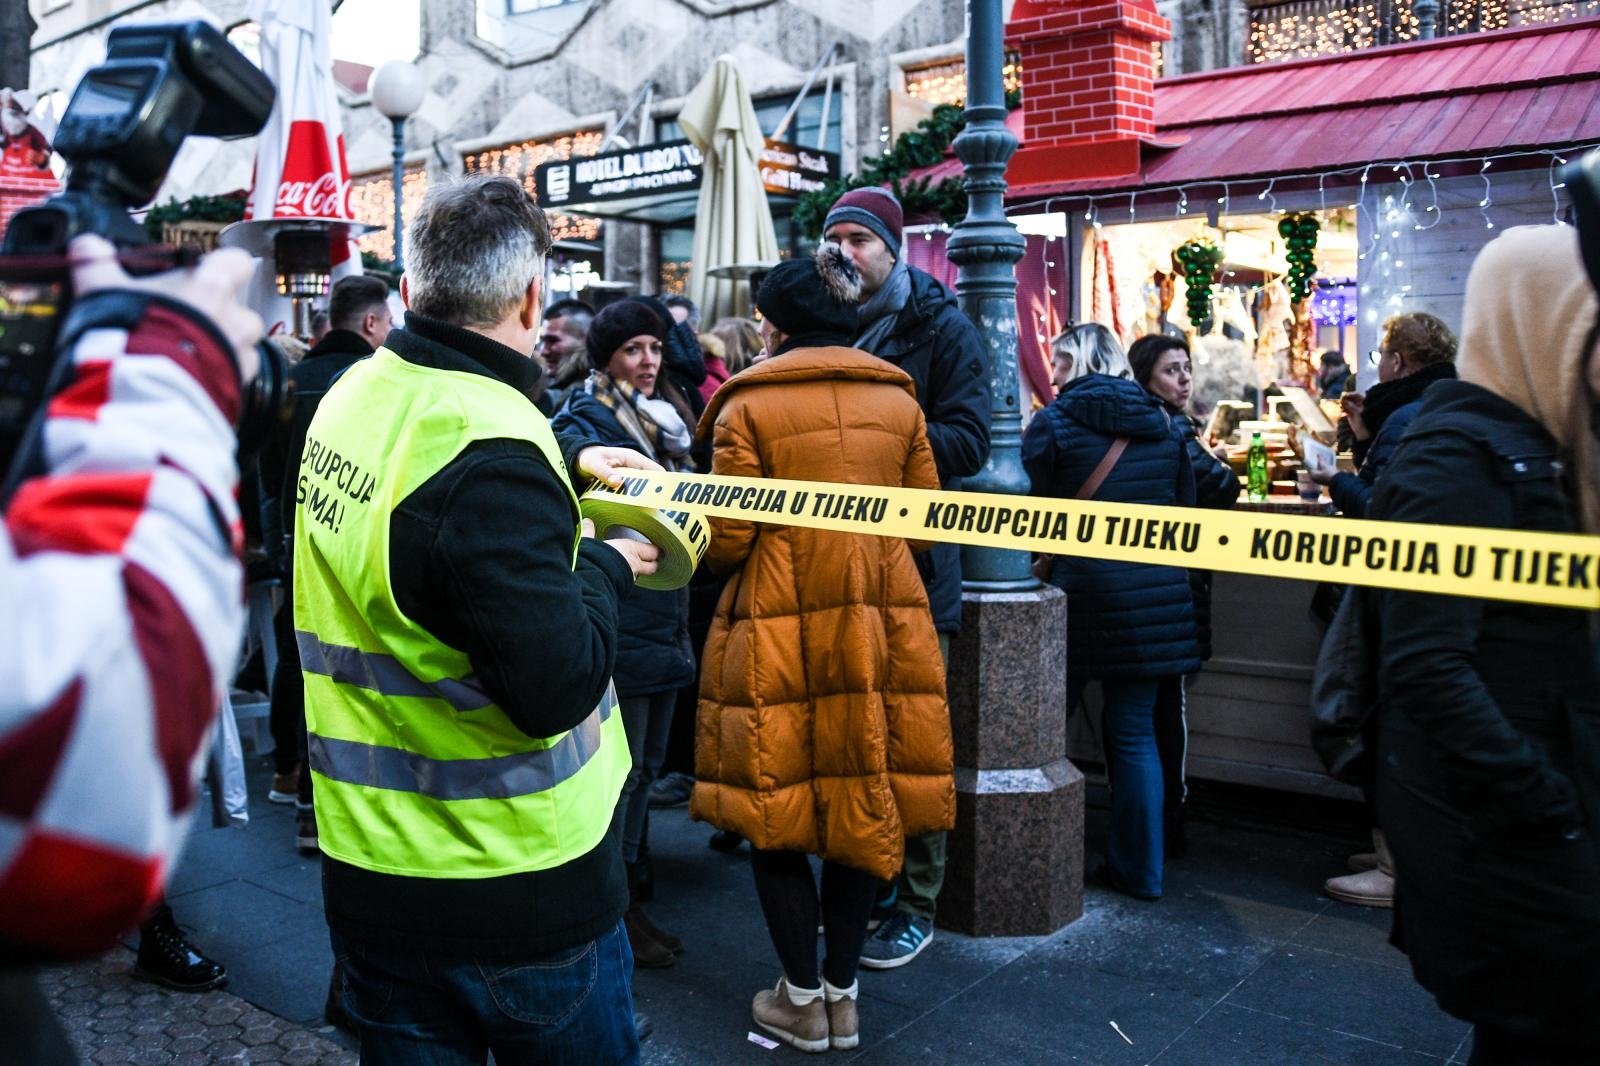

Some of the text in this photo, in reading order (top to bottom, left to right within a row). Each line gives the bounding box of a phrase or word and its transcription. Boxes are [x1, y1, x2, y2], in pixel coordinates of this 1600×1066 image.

[670, 482, 784, 514] KORUPCIJA
[790, 491, 809, 516] U
[811, 493, 889, 524] TIJEKU
[923, 502, 1067, 541] KORUPCIJA
[1076, 514, 1097, 544] U
[1105, 516, 1202, 553] TIJEKU
[1249, 527, 1440, 576] KORUPCIJA
[1453, 544, 1477, 579] U
[1489, 547, 1600, 590] TIJEK
